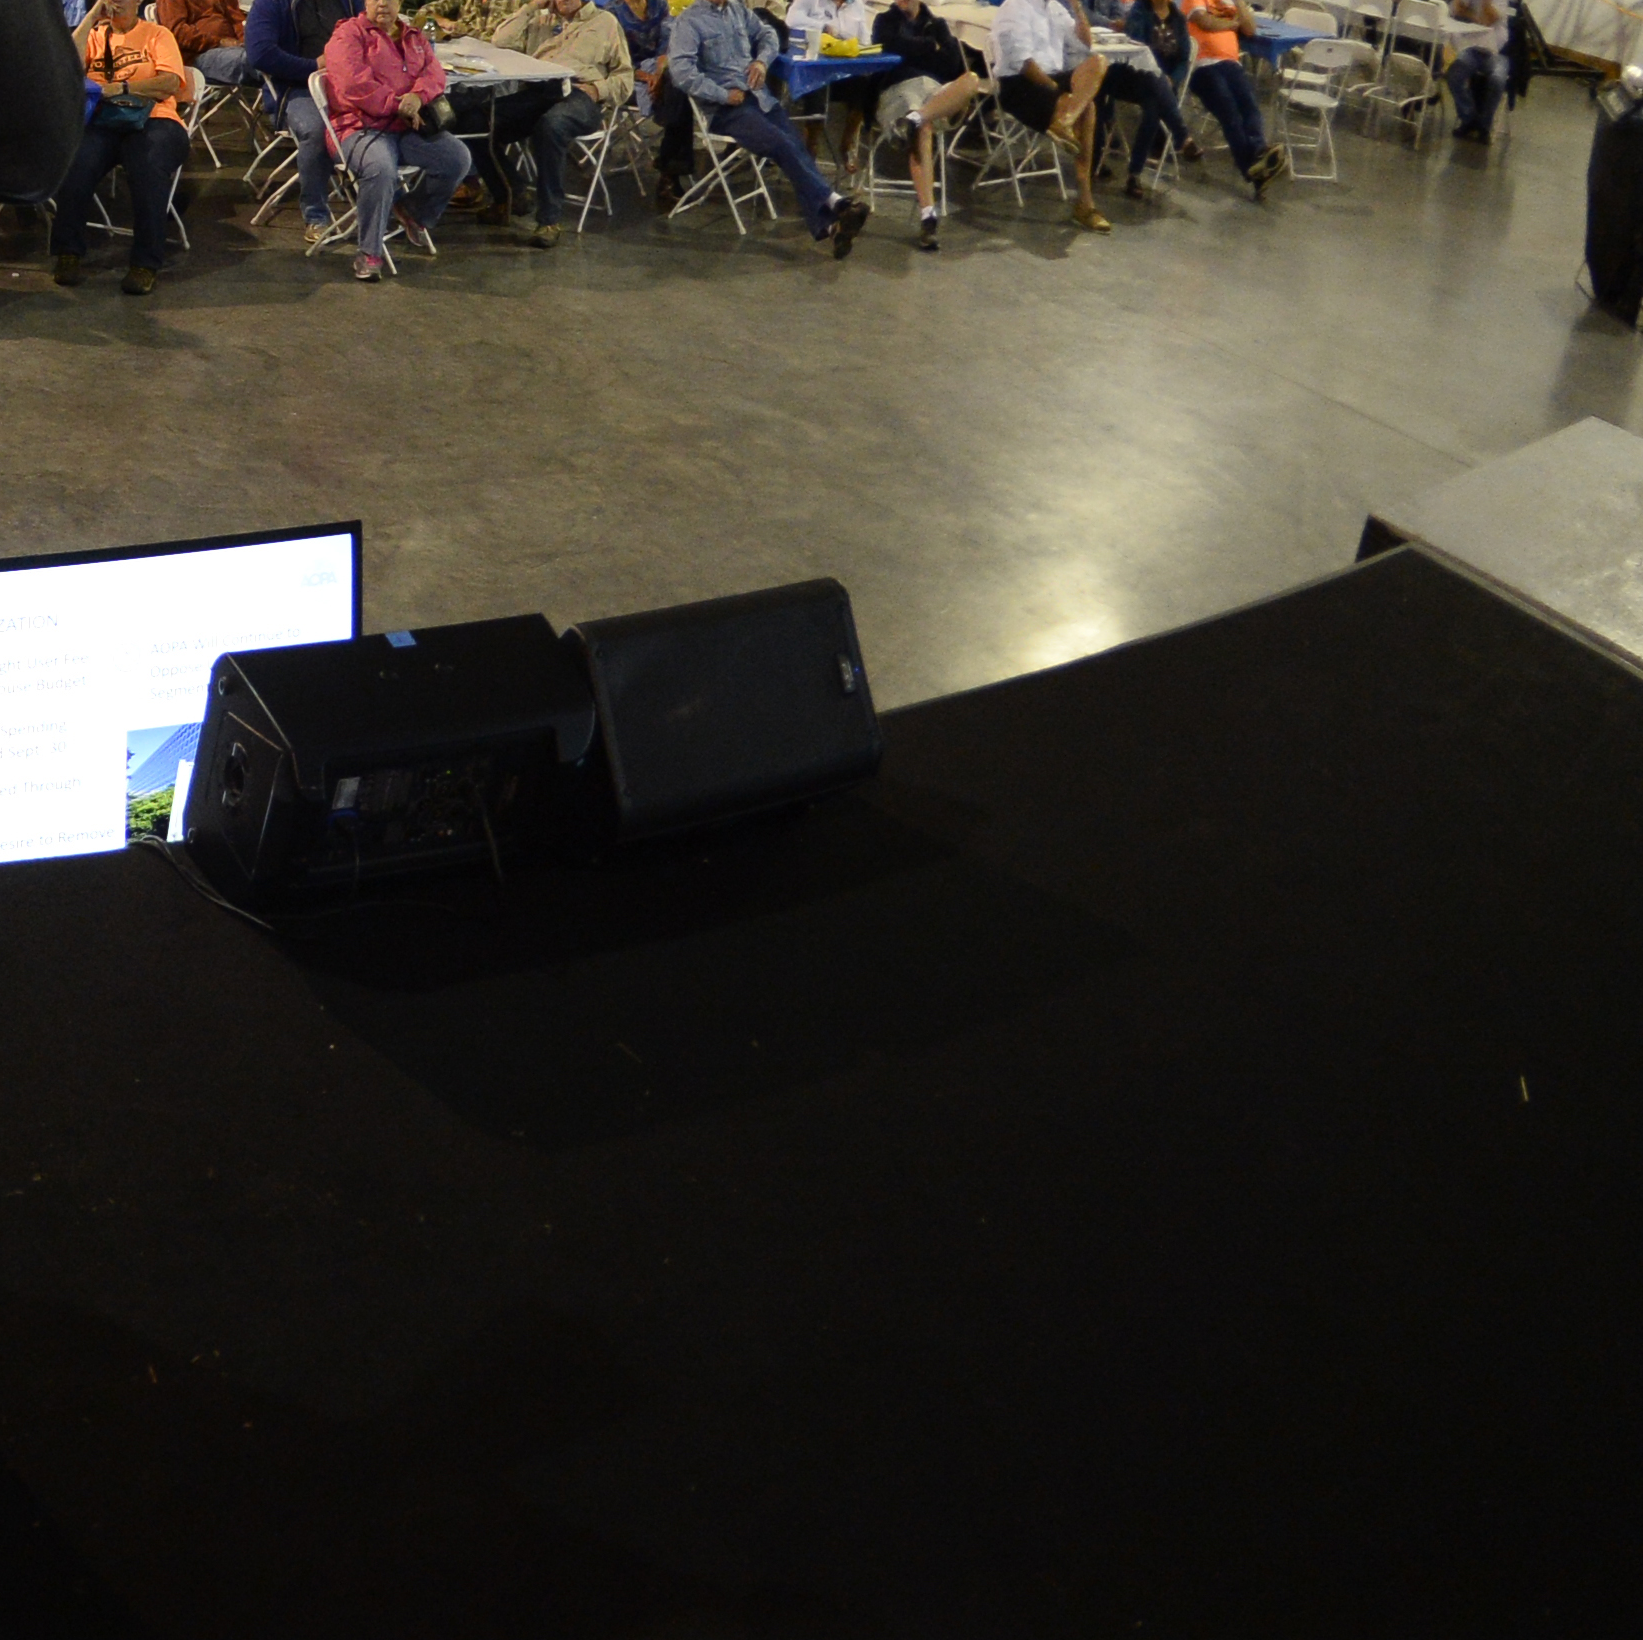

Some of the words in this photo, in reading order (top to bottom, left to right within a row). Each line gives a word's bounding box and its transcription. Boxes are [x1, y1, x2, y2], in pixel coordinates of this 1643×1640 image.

[300, 571, 338, 588] AOPA
[151, 640, 188, 655] AOPA
[192, 636, 218, 650] Will
[223, 630, 284, 647] Continue
[287, 627, 301, 639] to
[150, 663, 203, 679] Oppose
[36, 676, 86, 692] Budget
[150, 683, 204, 701] Segmen
[1, 720, 67, 737] Spending
[51, 740, 67, 754] 30
[24, 777, 82, 794] Through
[39, 834, 53, 846] to
[58, 826, 115, 844] Remove
